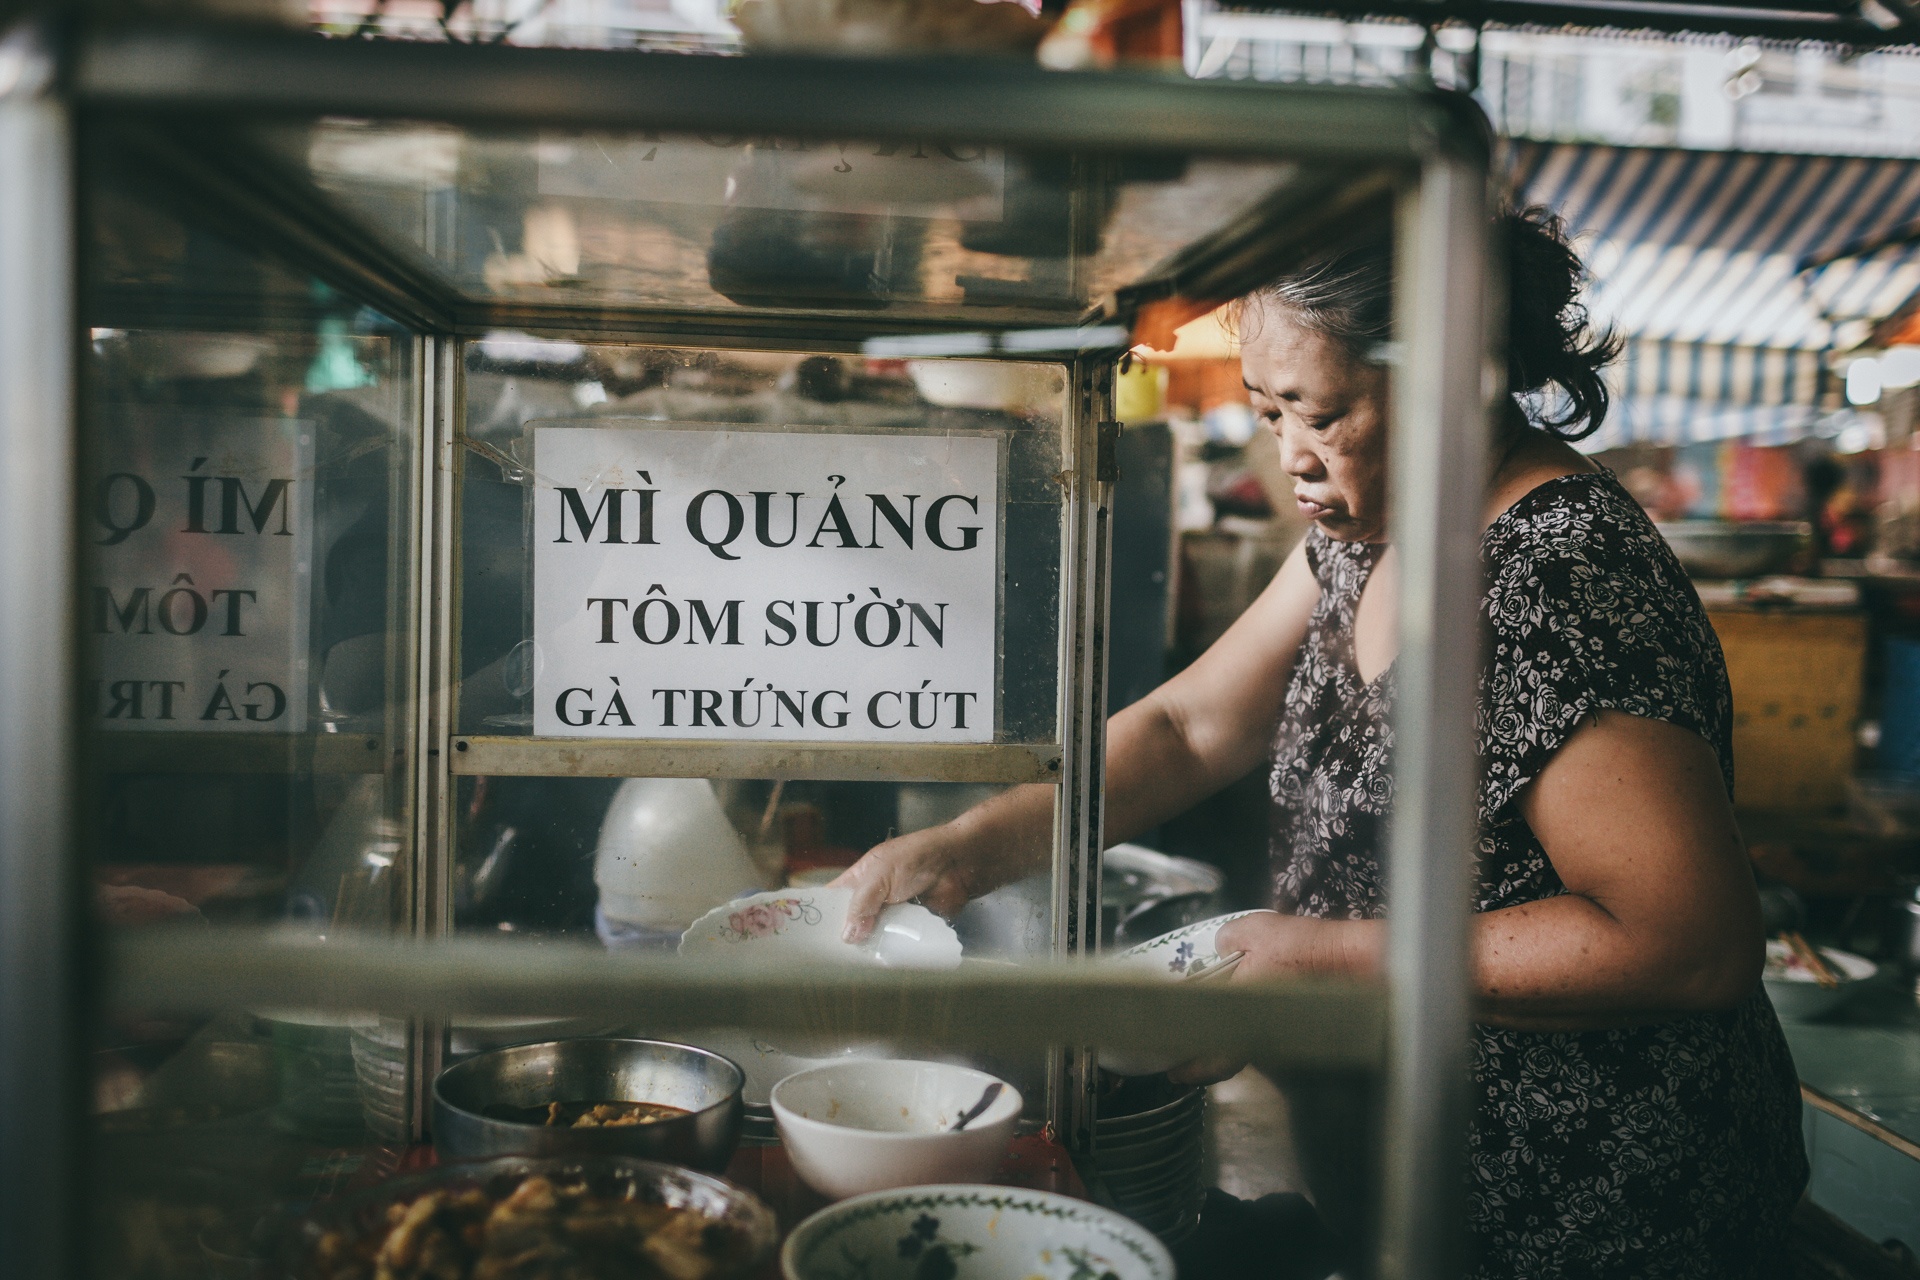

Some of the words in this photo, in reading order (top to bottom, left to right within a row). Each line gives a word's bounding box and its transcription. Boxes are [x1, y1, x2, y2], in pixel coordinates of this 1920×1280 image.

[553, 470, 661, 545] MÌ
[686, 474, 984, 561] QUẢNG
[587, 583, 745, 645] TÔM
[765, 587, 949, 649] SƯỜN
[555, 677, 636, 727] GÀ
[652, 677, 851, 729] TRỨNG
[867, 679, 977, 730] CÚT
